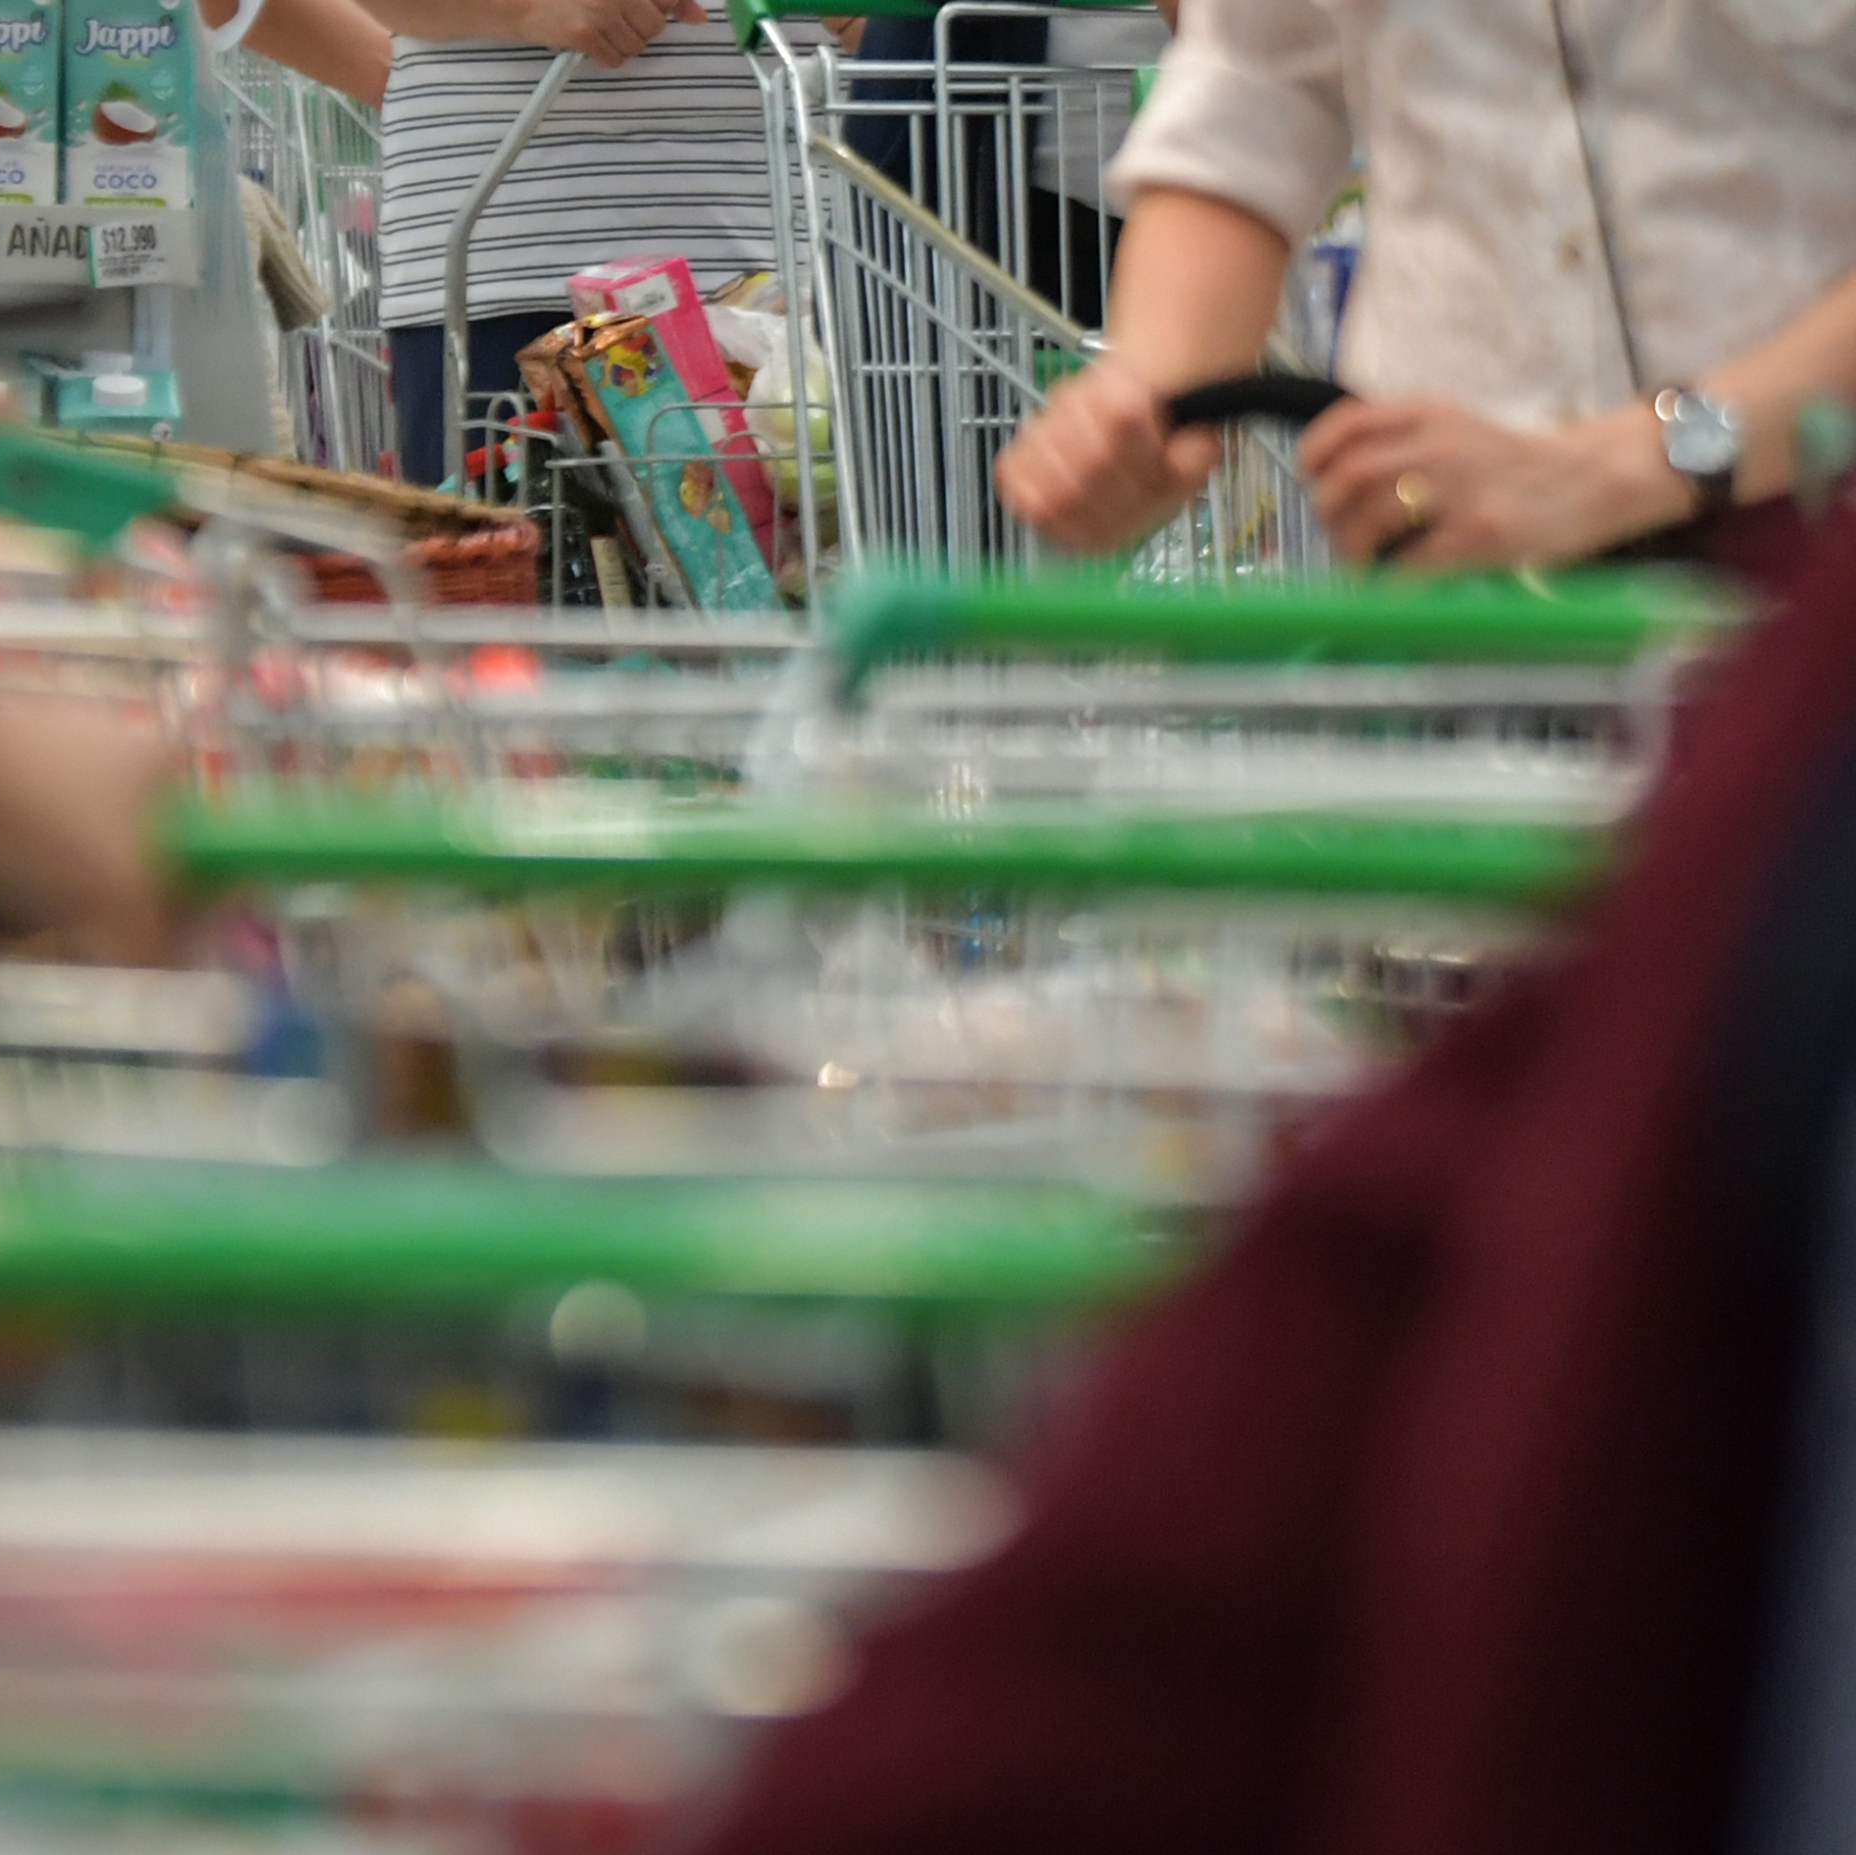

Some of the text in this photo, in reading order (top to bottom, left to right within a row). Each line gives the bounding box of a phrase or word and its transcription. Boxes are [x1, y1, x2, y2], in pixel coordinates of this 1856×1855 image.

[75, 14, 178, 59] Jappi
[93, 174, 158, 190] COCO
[6, 217, 89, 260] AÑAD
